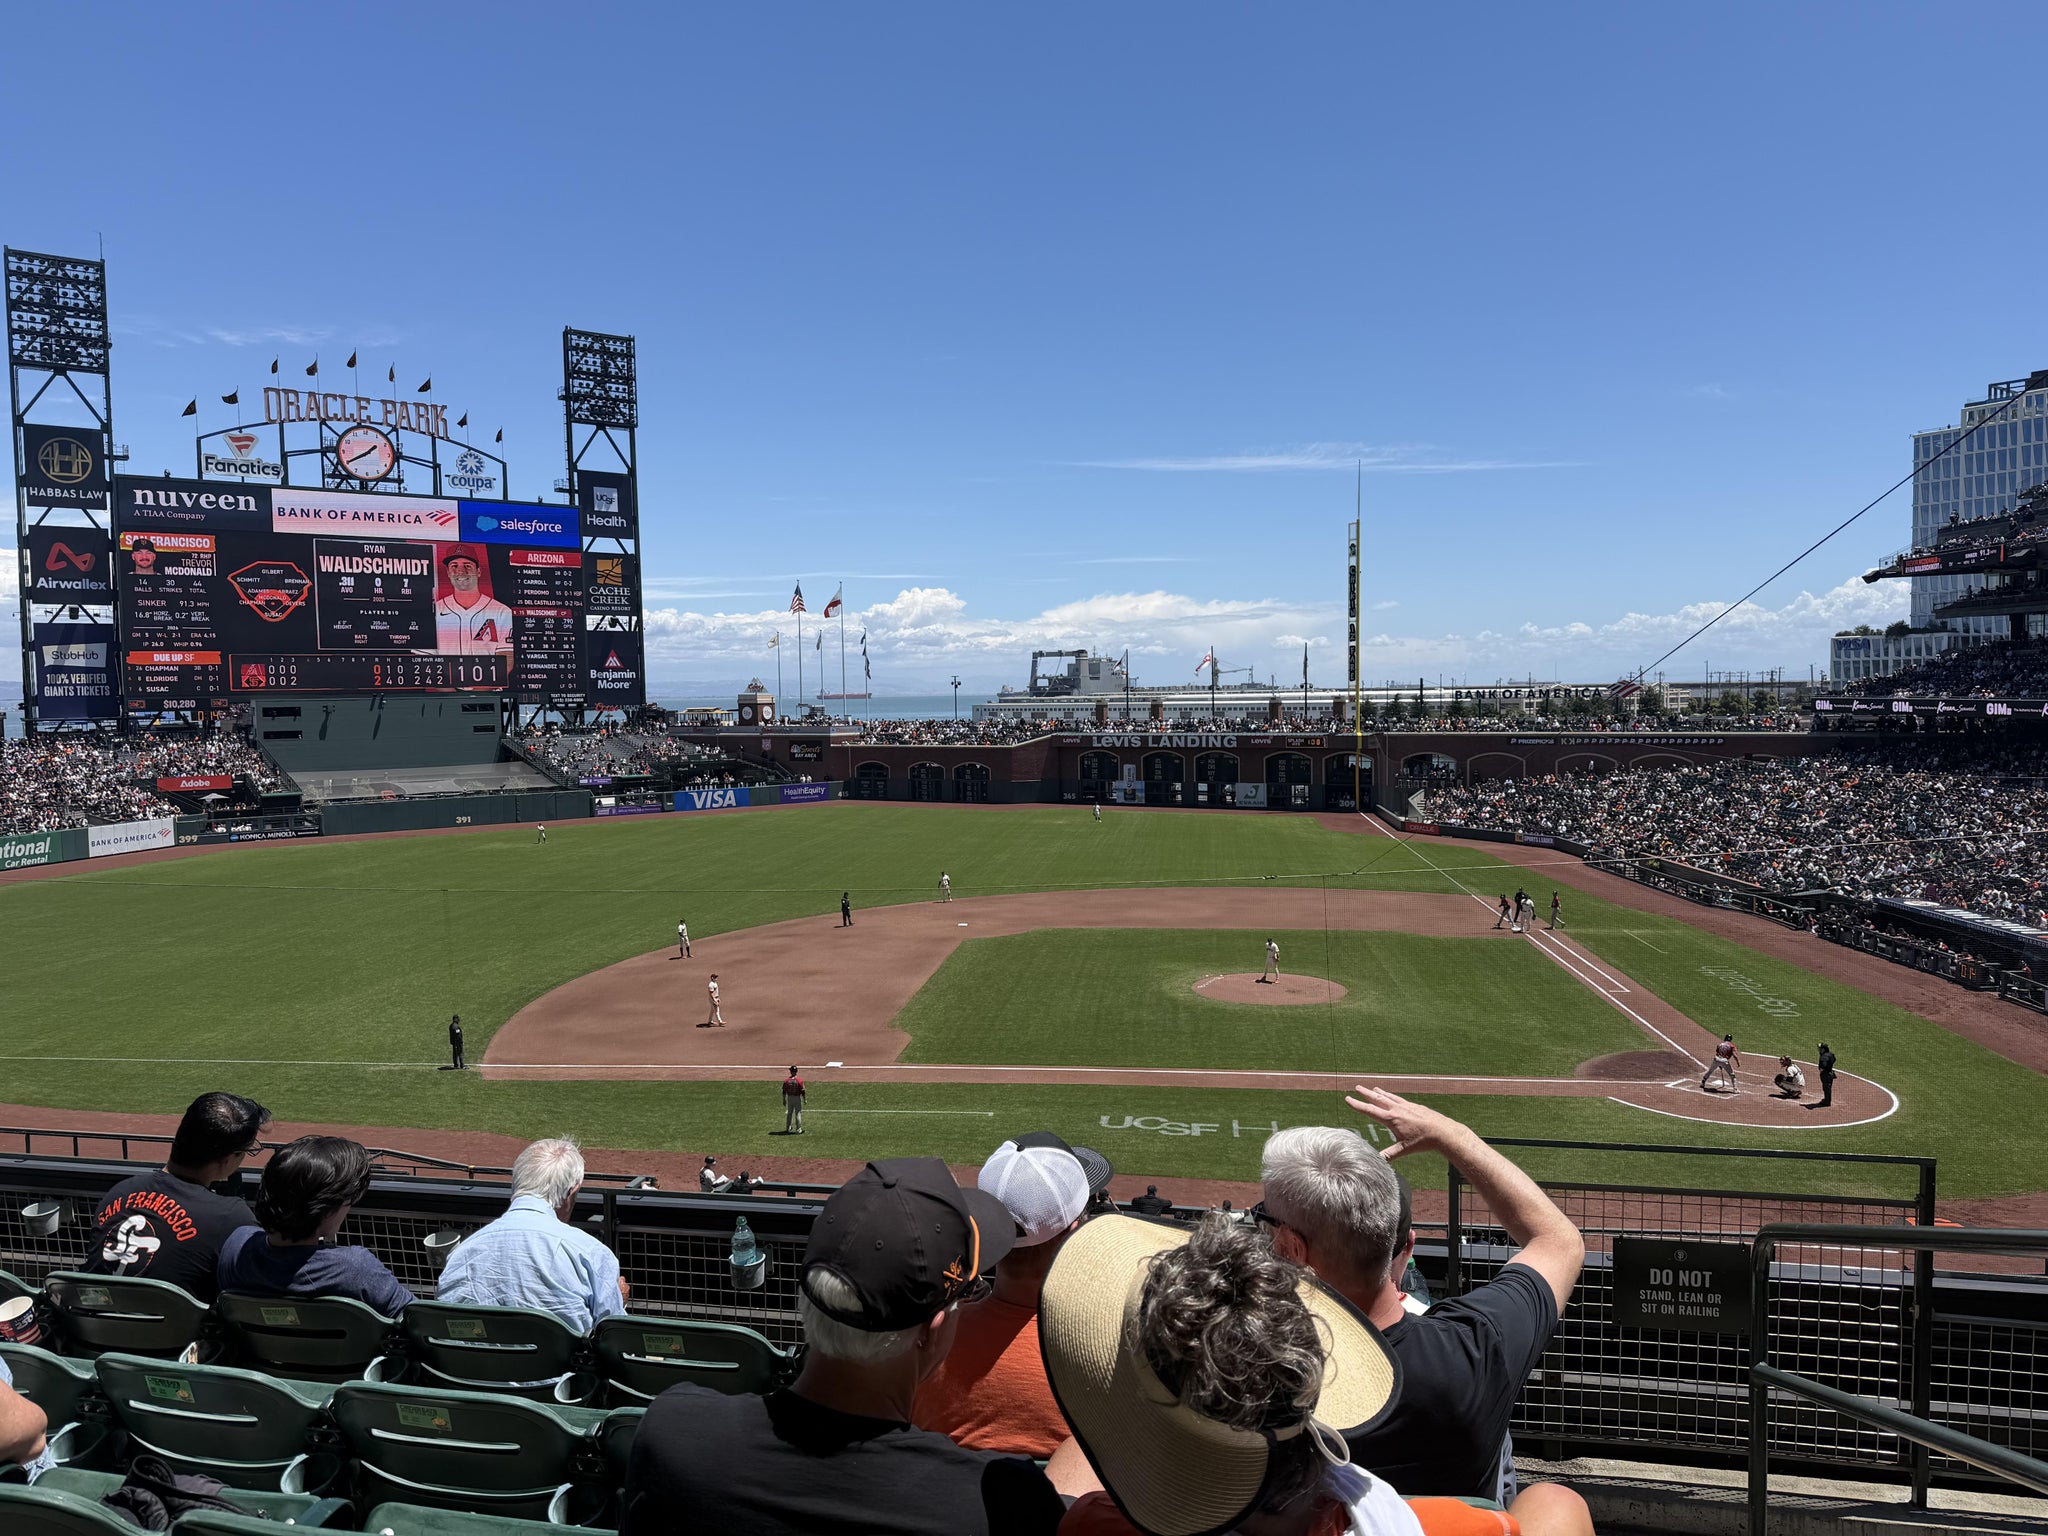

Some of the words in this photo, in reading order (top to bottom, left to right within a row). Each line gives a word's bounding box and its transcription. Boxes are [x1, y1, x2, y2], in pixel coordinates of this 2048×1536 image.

[263, 388, 371, 424] ORACLE
[381, 399, 449, 440] PARK
[204, 456, 281, 476] Fanatics
[452, 476, 492, 490] coupa
[30, 487, 76, 498] HABBAS
[80, 490, 103, 500] LAW
[596, 494, 615, 504] UCSF
[133, 489, 258, 511] nuveen
[166, 512, 206, 521] Company
[278, 507, 322, 518] BANK
[328, 510, 347, 520] OF
[352, 512, 422, 524] AMERICA
[586, 514, 626, 527] Health
[500, 518, 562, 534] salesforce
[150, 536, 210, 548] FRANCISCO
[364, 545, 385, 553] RYAN
[181, 559, 212, 567] TREVOR
[528, 553, 565, 563] ARIZONA
[165, 567, 212, 576] MCDONALD
[319, 556, 429, 575] WALDSCHMIDT
[36, 577, 107, 590] Airwallex
[590, 586, 630, 595] CACHE
[591, 596, 629, 604] CREEK
[1835, 638, 1870, 650] VISA
[51, 651, 98, 660] StubHub
[268, 665, 275, 674] 0
[280, 665, 286, 674] 0
[290, 665, 296, 674] 0
[374, 665, 380, 674] 0
[398, 665, 404, 673] 0
[458, 666, 464, 681] 1
[473, 666, 482, 681] 0
[490, 666, 496, 681] 1
[590, 670, 636, 680] Benjamin
[46, 674, 69, 684] 100%
[71, 674, 106, 684] VERIFIED
[269, 676, 276, 685] 0
[280, 676, 286, 685] 0
[290, 677, 296, 685] 2
[374, 676, 381, 685] 2
[398, 676, 404, 685] 0
[598, 680, 629, 689] Moore
[44, 686, 74, 696] GIANTS
[77, 686, 110, 696] TICKETS
[1455, 690, 1497, 700] BANK
[1503, 689, 1522, 699] OF
[1527, 687, 1601, 699] AMERICA
[164, 700, 196, 708] $10,280
[1148, 736, 1237, 748] LANDING
[784, 786, 825, 796] HealthEquity
[688, 790, 736, 809] VISA
[92, 839, 111, 847] BANK
[125, 833, 157, 843] AMERICA
[179, 835, 198, 843] 399
[5, 858, 19, 868] Car
[21, 855, 48, 865] Rental
[1100, 1116, 1219, 1136] UCSF
[98, 1197, 122, 1226] SAN
[125, 1191, 198, 1241] FRANCISCO
[1650, 1268, 1673, 1286] DO
[1679, 1270, 1712, 1288] NOT
[1679, 1292, 1703, 1303] LEAN
[1708, 1293, 1722, 1304] OR
[1642, 1303, 1658, 1313] SIT
[1661, 1304, 1674, 1314] ON
[1679, 1305, 1720, 1318] RAILING
